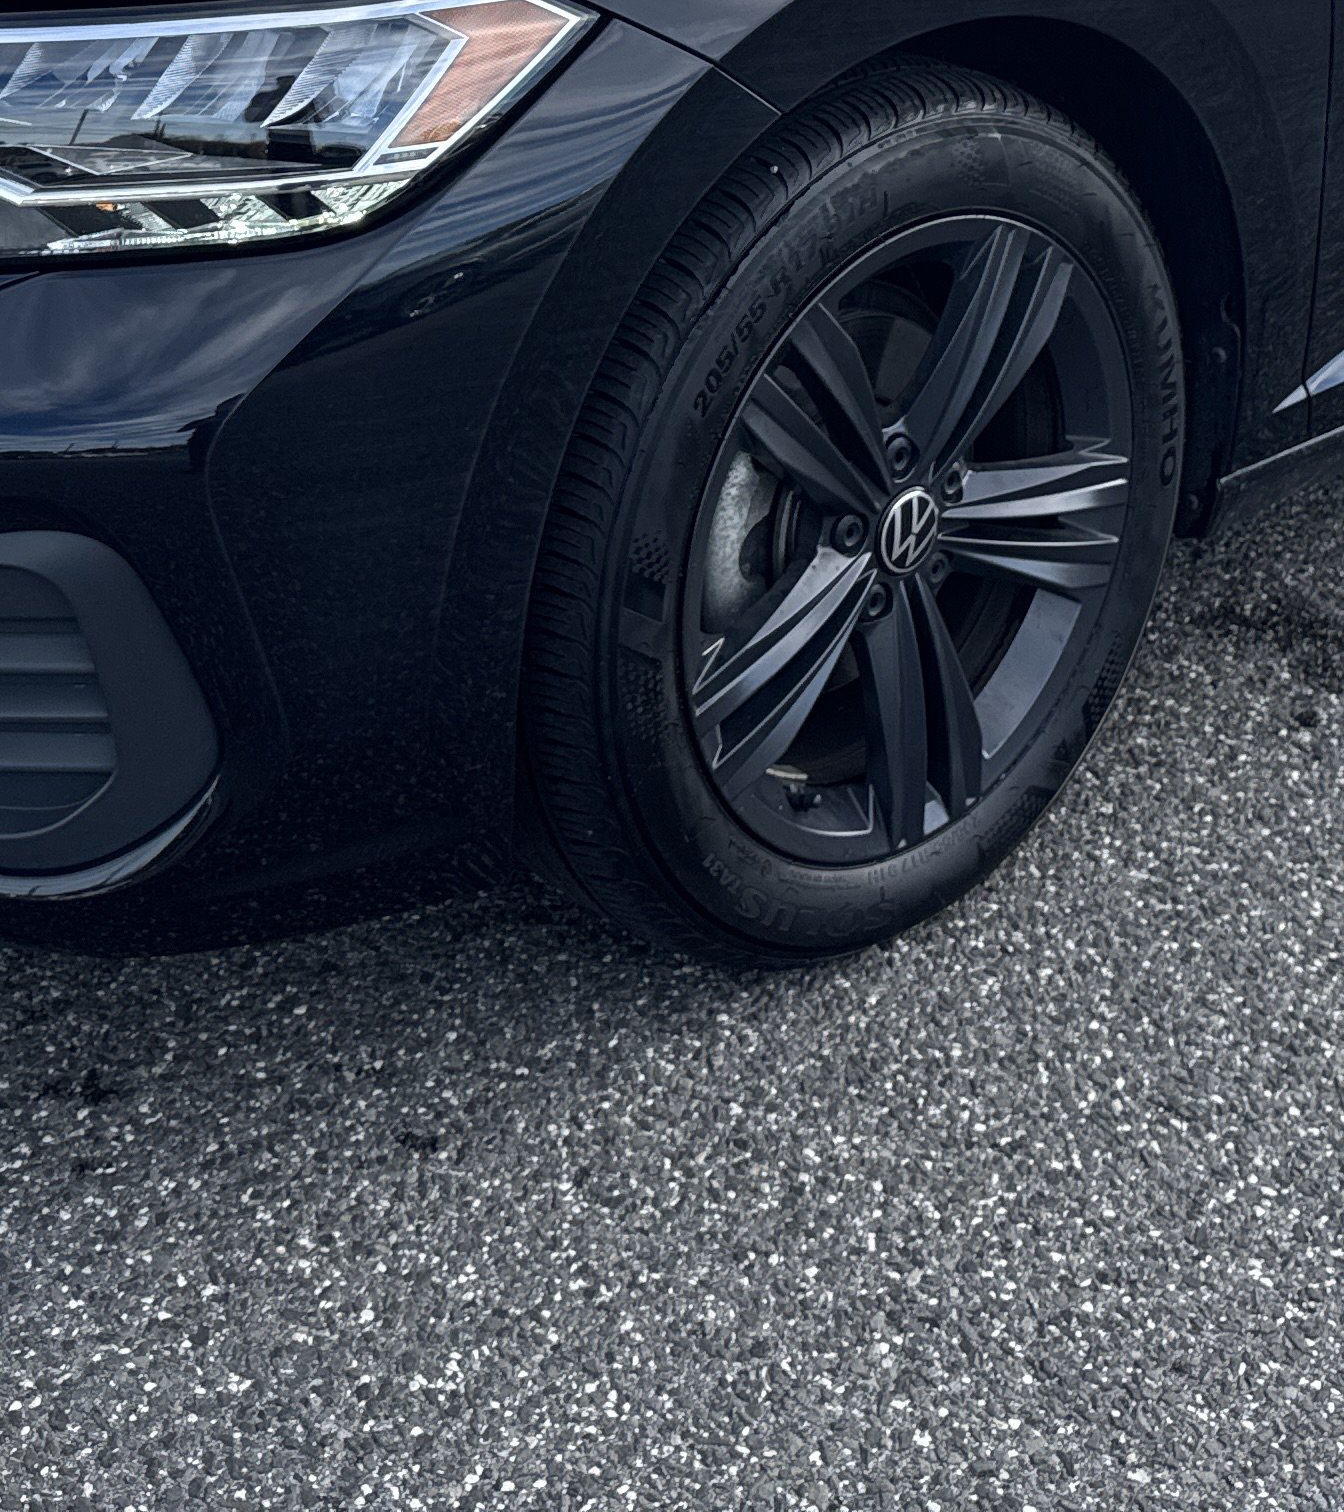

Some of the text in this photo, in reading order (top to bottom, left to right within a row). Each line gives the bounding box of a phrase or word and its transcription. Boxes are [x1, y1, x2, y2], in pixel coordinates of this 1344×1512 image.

[692, 295, 767, 419] 205/55
[1152, 284, 1179, 487] KUMHO
[702, 852, 742, 894] TA31
